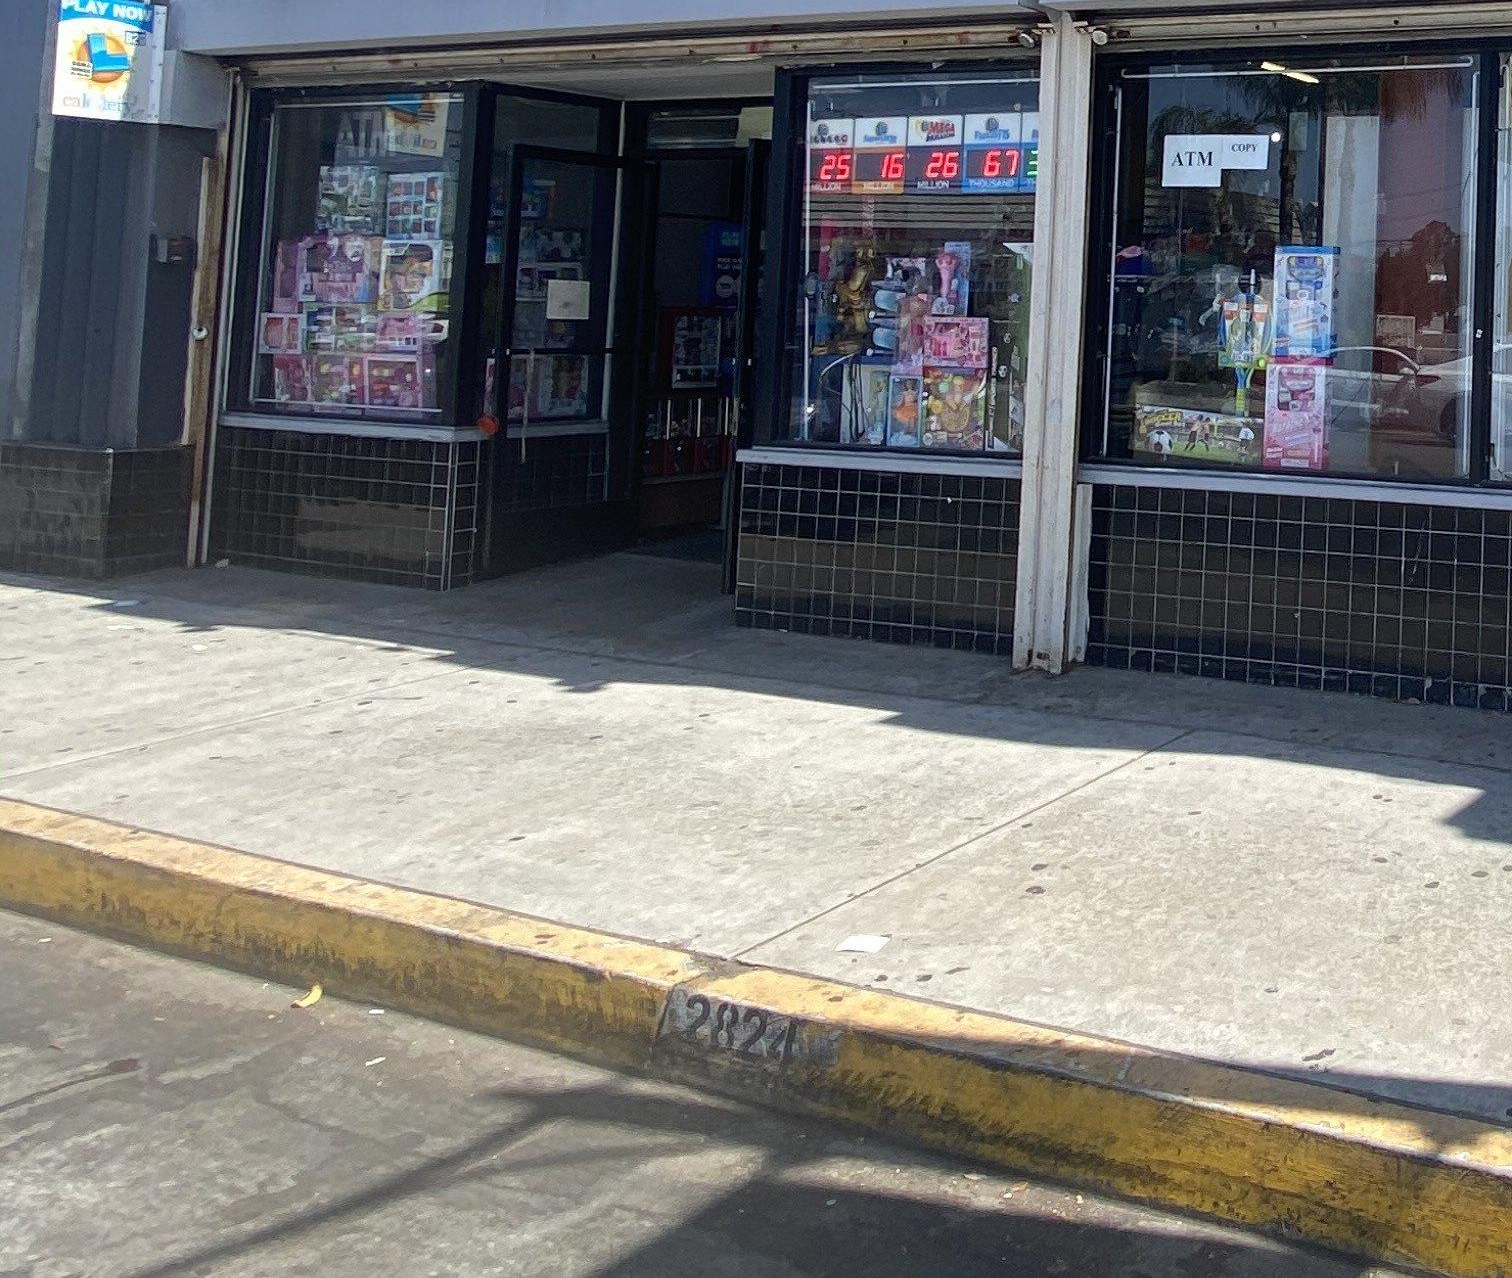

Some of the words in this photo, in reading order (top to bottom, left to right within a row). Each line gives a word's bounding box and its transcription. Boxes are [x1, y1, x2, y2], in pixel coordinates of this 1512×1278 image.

[112, 3, 152, 21] NOW
[1231, 143, 1257, 152] COPY
[820, 154, 851, 180] 25
[881, 153, 904, 178] 16
[926, 151, 960, 178] 26
[983, 149, 1020, 176] 67
[1171, 151, 1213, 166] ATM
[917, 180, 949, 190] MILLION
